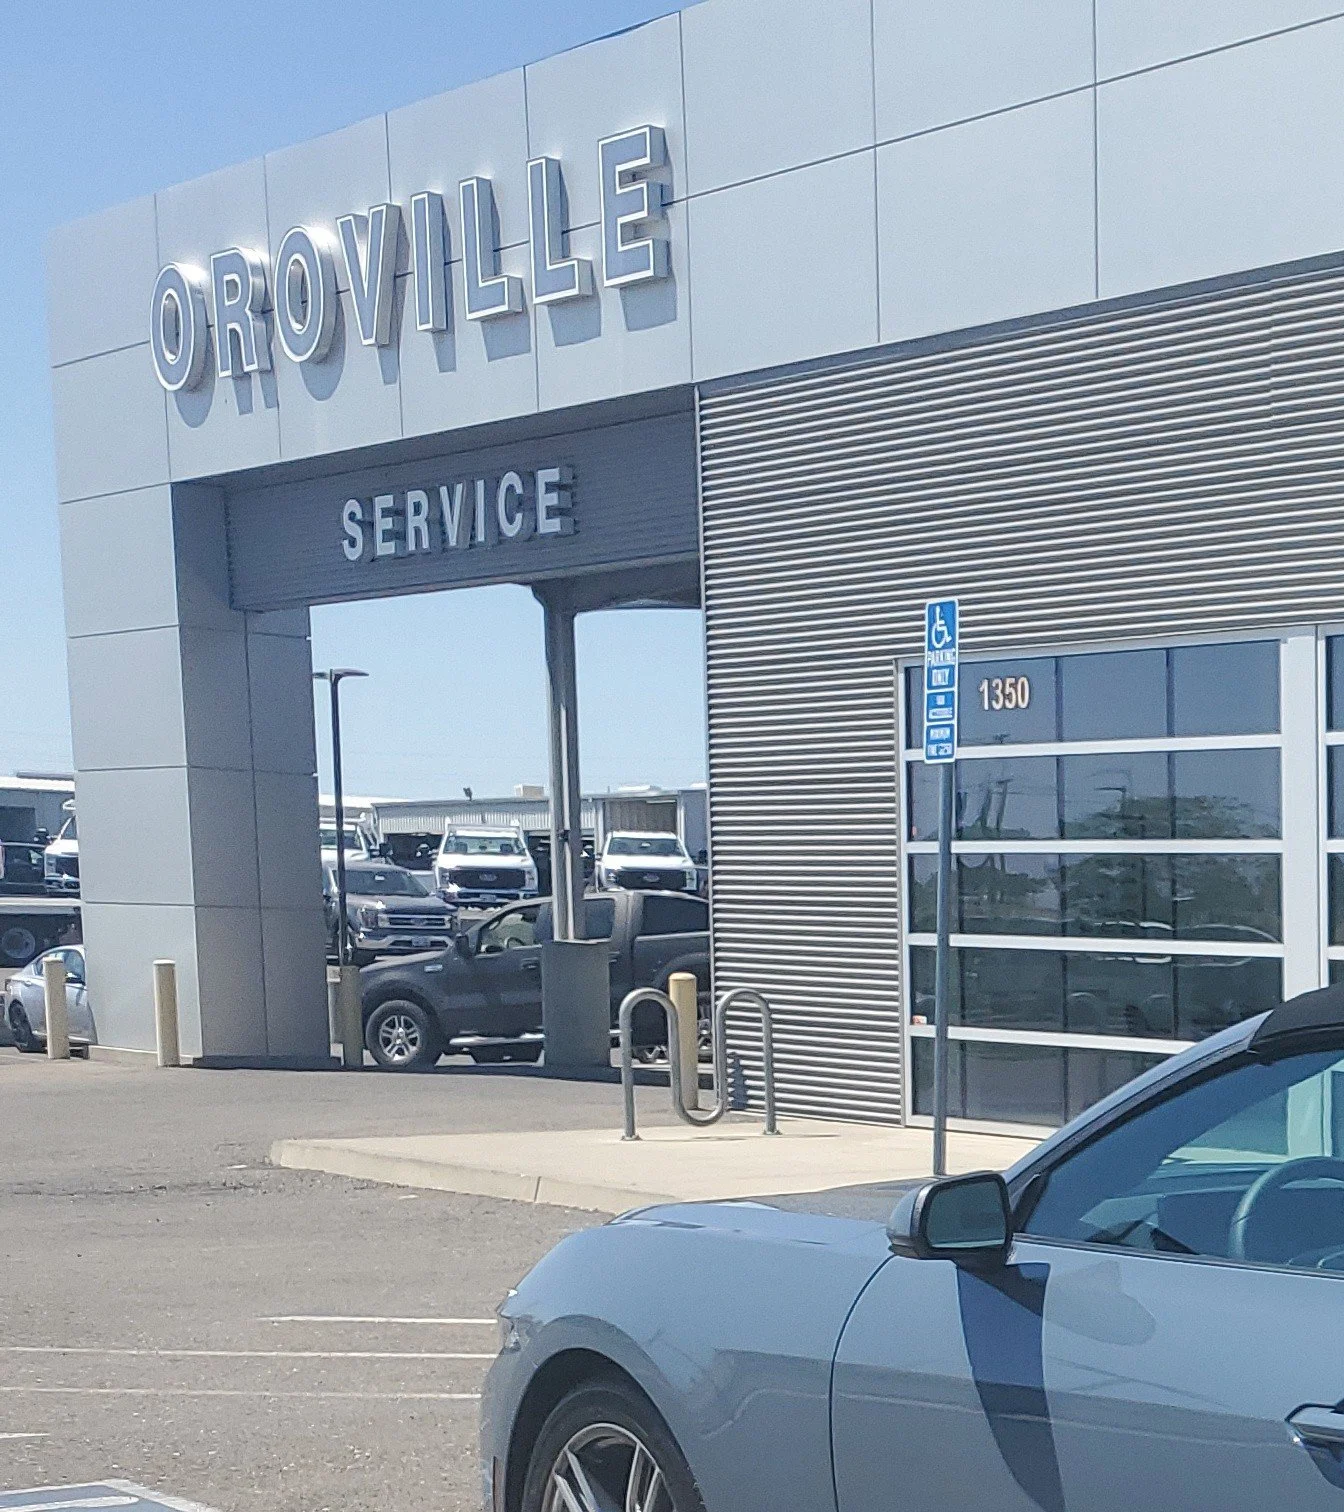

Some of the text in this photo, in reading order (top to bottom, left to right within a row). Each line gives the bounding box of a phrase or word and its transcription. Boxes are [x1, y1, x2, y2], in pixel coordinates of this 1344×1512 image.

[150, 125, 671, 393] OROVILLE
[341, 467, 564, 562] SERVICE
[979, 677, 1030, 711] 1350
